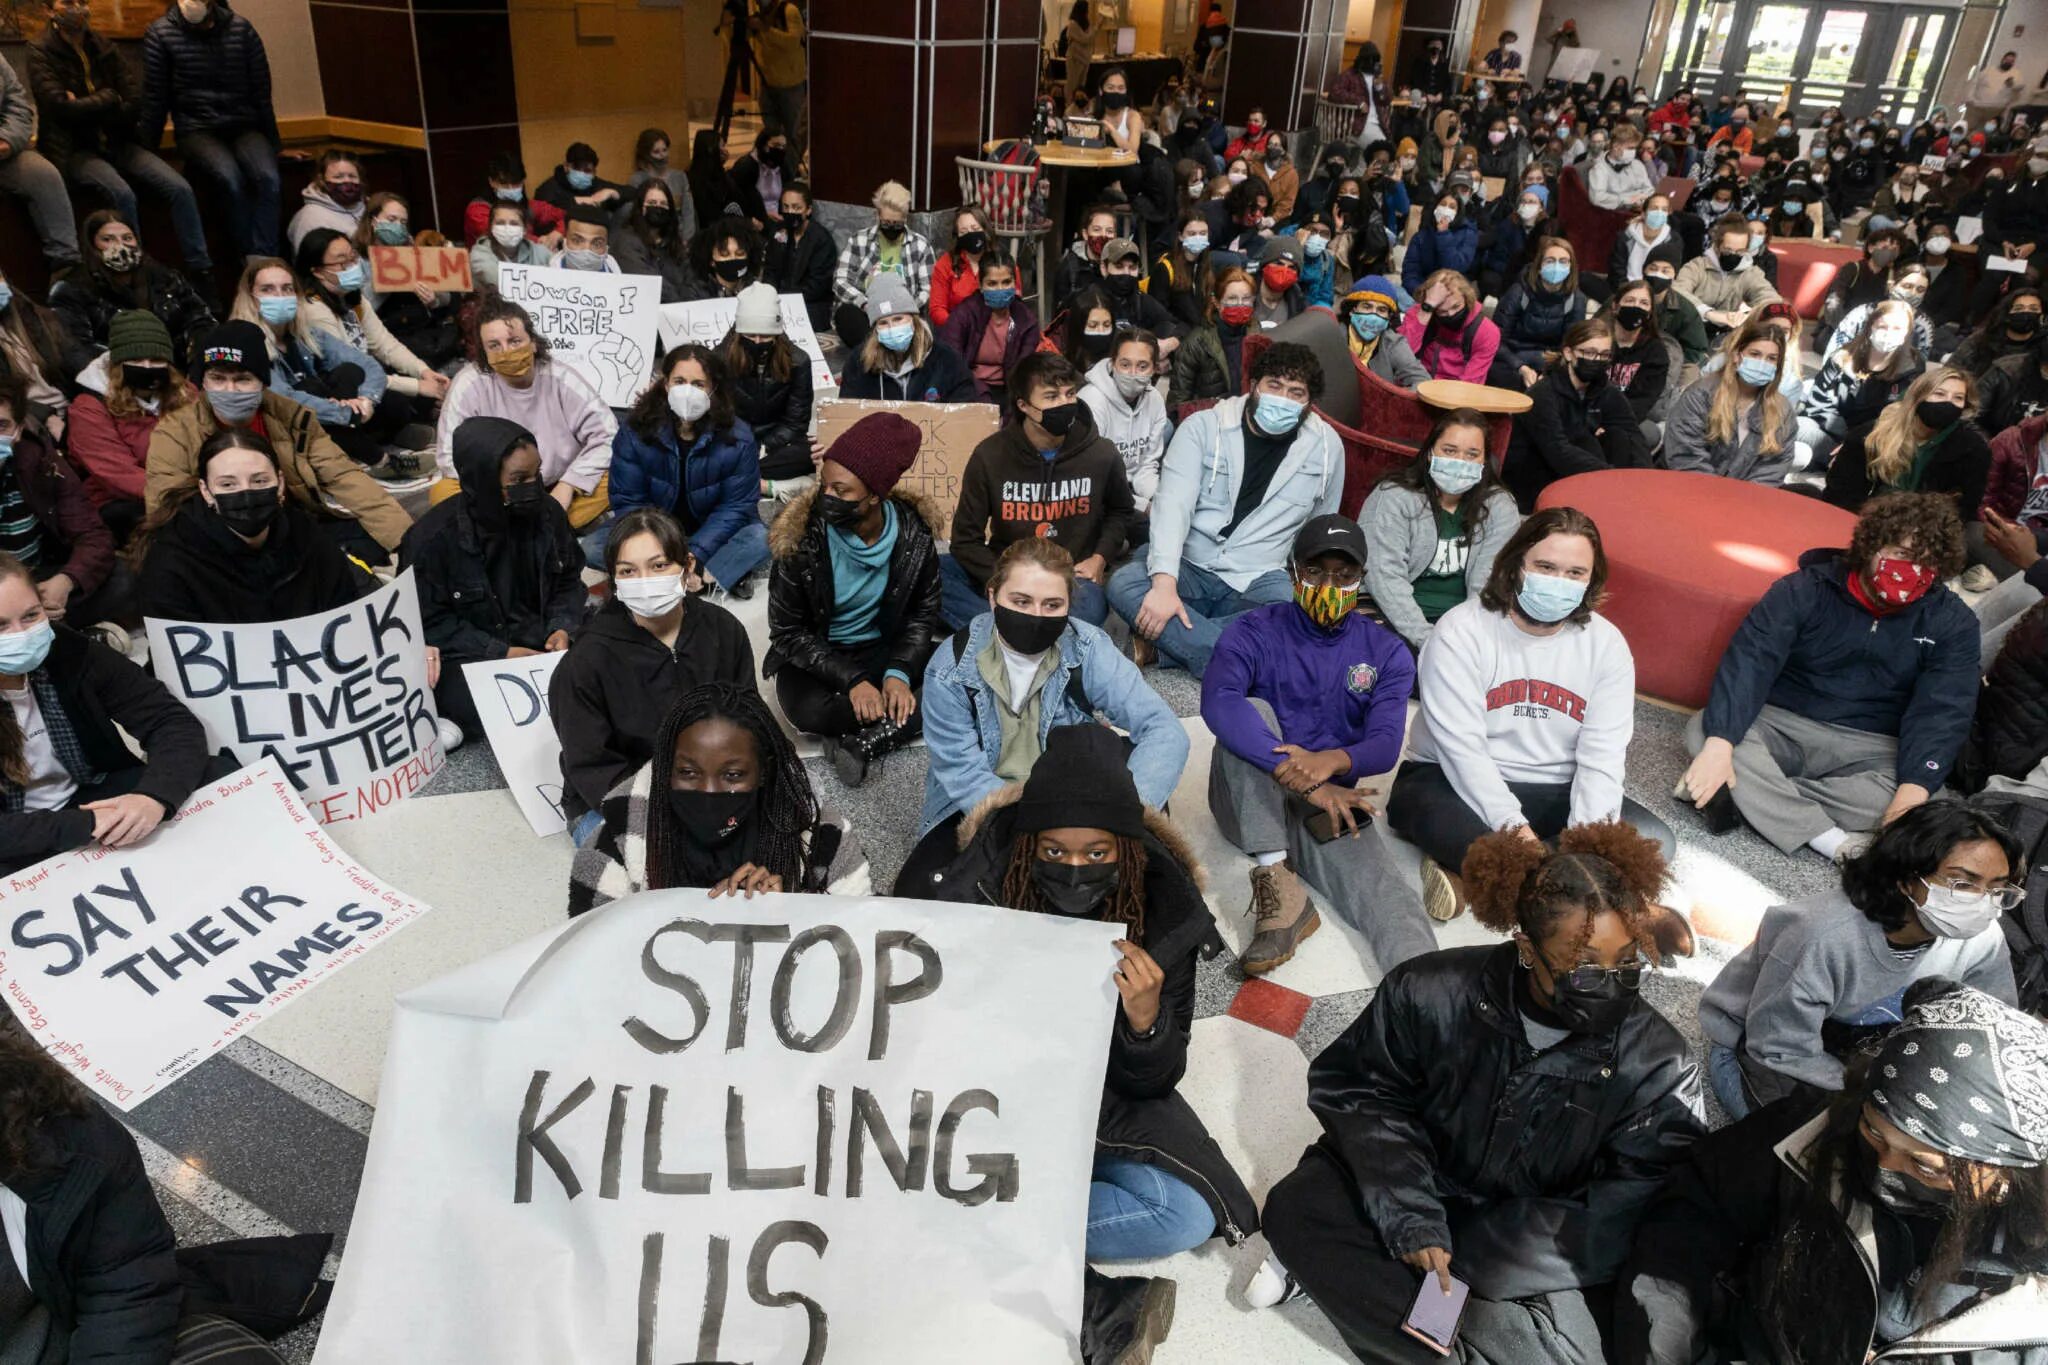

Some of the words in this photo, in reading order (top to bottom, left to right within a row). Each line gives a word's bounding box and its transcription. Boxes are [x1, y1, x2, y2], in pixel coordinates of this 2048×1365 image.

[372, 246, 471, 289] BLM
[502, 268, 566, 301] How
[566, 286, 608, 309] Can
[619, 286, 638, 314] I
[541, 305, 613, 336] FREE
[1002, 497, 1091, 521] BROWNS
[165, 589, 411, 698] BLACK
[230, 653, 407, 744] LIVES
[216, 688, 439, 791] ATTER
[217, 775, 254, 798] Bland
[356, 777, 392, 818] NO
[272, 781, 306, 824] Ahmaud
[304, 830, 334, 864] Arbery
[344, 865, 380, 896] Freddie
[11, 866, 157, 977] SAY
[101, 884, 307, 998] THEIR
[326, 943, 366, 970] Martin
[203, 902, 384, 1019] NAMES
[622, 917, 944, 1061] STOP
[8, 979, 48, 1030] Breonna
[223, 1011, 262, 1037] Scott
[95, 1068, 134, 1102] Daunte
[514, 1069, 1020, 1207] KILLING
[636, 1220, 830, 1365] US
